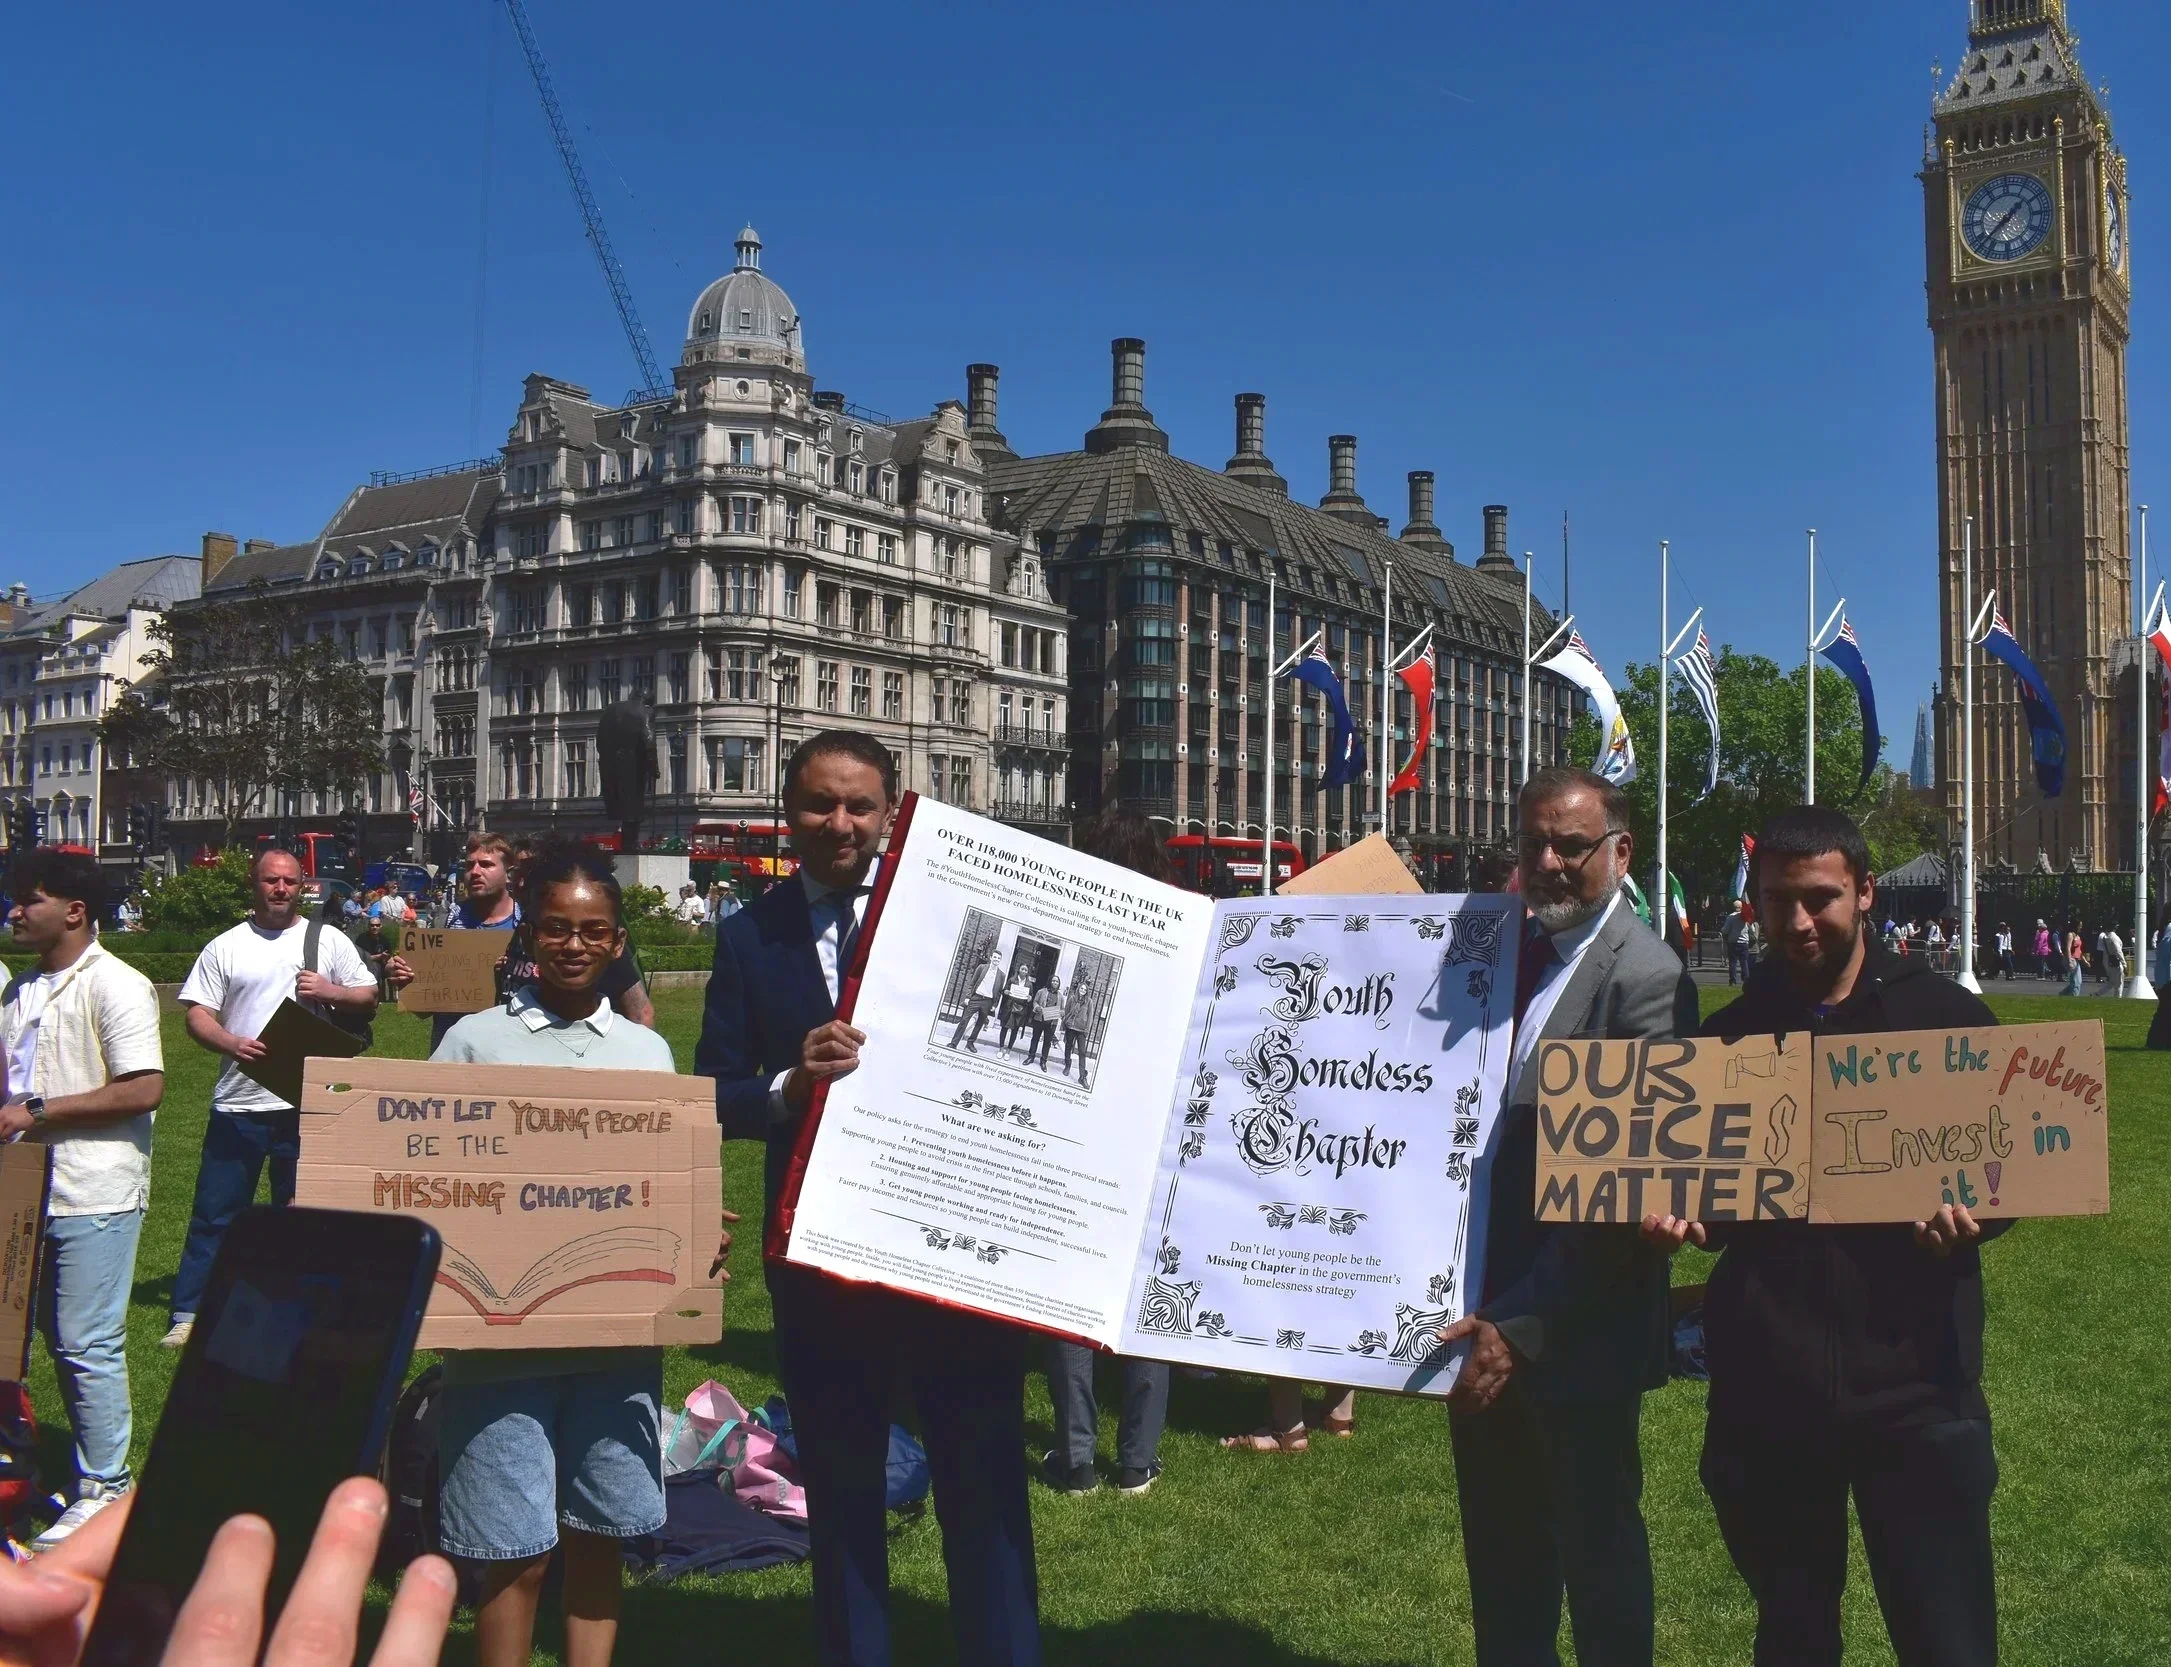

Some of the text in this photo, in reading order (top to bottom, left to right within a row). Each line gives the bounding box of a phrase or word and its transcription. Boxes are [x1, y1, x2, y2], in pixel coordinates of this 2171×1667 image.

[926, 858, 940, 869] The
[940, 863, 1025, 898] #YouthHomelessChapter
[1024, 892, 1059, 911] Collective
[1059, 904, 1066, 913] is
[1066, 909, 1090, 923] calling
[1091, 915, 1102, 925] for
[1107, 922, 1154, 942] youth-specific
[1154, 938, 1179, 951] chapter
[937, 828, 1184, 922] OVER 118,000 YOUNG PEOPLE IN THE UK
[947, 847, 1166, 931] FACED HOMELESSNESS LAST YEAR
[927, 869, 935, 879] in
[936, 873, 948, 883] the
[948, 876, 996, 900] Government's
[996, 895, 1013, 905] new
[1012, 900, 1076, 927] cross-departmental
[1076, 922, 1104, 937] strategy
[1111, 934, 1125, 943] end
[1125, 937, 1171, 959] homelessness.
[422, 988, 483, 1001] THRIVE
[1253, 952, 1395, 1034] Youth
[1225, 1026, 1433, 1096] Homeless
[1539, 1039, 1696, 1105] OUR
[1827, 1036, 2103, 1112] We're the future,
[378, 1097, 671, 1139] DON'T LET YOUNG PEOPLE
[407, 1134, 508, 1157] BE THE
[853, 1105, 1121, 1190] Our policy asks for the strategy to end youth homelessness fall into three practical strands:
[941, 1113, 1047, 1152] What are we asking for?
[1229, 1099, 1406, 1179] Chapter
[1824, 1105, 2070, 1175] Invest in
[374, 1173, 506, 1214] MISSING
[840, 1126, 876, 1144] Supporting
[876, 1138, 897, 1150] young
[897, 1144, 920, 1155] people
[927, 1152, 946, 1163] avoid
[944, 1158, 963, 1168] crisis
[963, 1161, 972, 1171] in
[971, 1164, 982, 1173] the
[982, 1167, 996, 1177] first
[994, 1172, 1013, 1182] place
[1013, 1176, 1038, 1190] through
[1037, 1185, 1063, 1198] schools,
[1063, 1190, 1089, 1206] families,
[1089, 1200, 1102, 1208] and
[1102, 1203, 1129, 1216] councils.
[870, 1160, 1090, 1230] Ensuring genuinely affordable and appropriate housing for young people.
[879, 1153, 1078, 1216] 2. Housing and support for young people facing homelessness.
[910, 1137, 947, 1155] Preventing
[946, 1149, 967, 1159] youth
[967, 1153, 1010, 1172] homelessness
[1011, 1166, 1032, 1178] before
[1032, 1172, 1039, 1180] it
[1038, 1174, 1068, 1188] happens.
[1535, 1168, 1794, 1222] MATTER
[838, 1176, 859, 1188] Fairer
[858, 1184, 872, 1193] pay
[871, 1185, 896, 1199] income
[896, 1194, 909, 1202] and
[908, 1198, 939, 1211] resources
[947, 1209, 969, 1221] young
[968, 1215, 991, 1226] people
[990, 1221, 1003, 1229] can
[1002, 1223, 1020, 1234] build
[1020, 1228, 1059, 1246] independent,
[1060, 1241, 1092, 1255] successful
[1091, 1248, 1108, 1259] lives.
[879, 1178, 1066, 1238] 3. Get young people working and ready for independence.
[1206, 1254, 1401, 1284] Missing Chapter in the government's
[1230, 1241, 1382, 1266] Don't let young people be the
[1243, 1275, 1356, 1298] homelessness strategy
